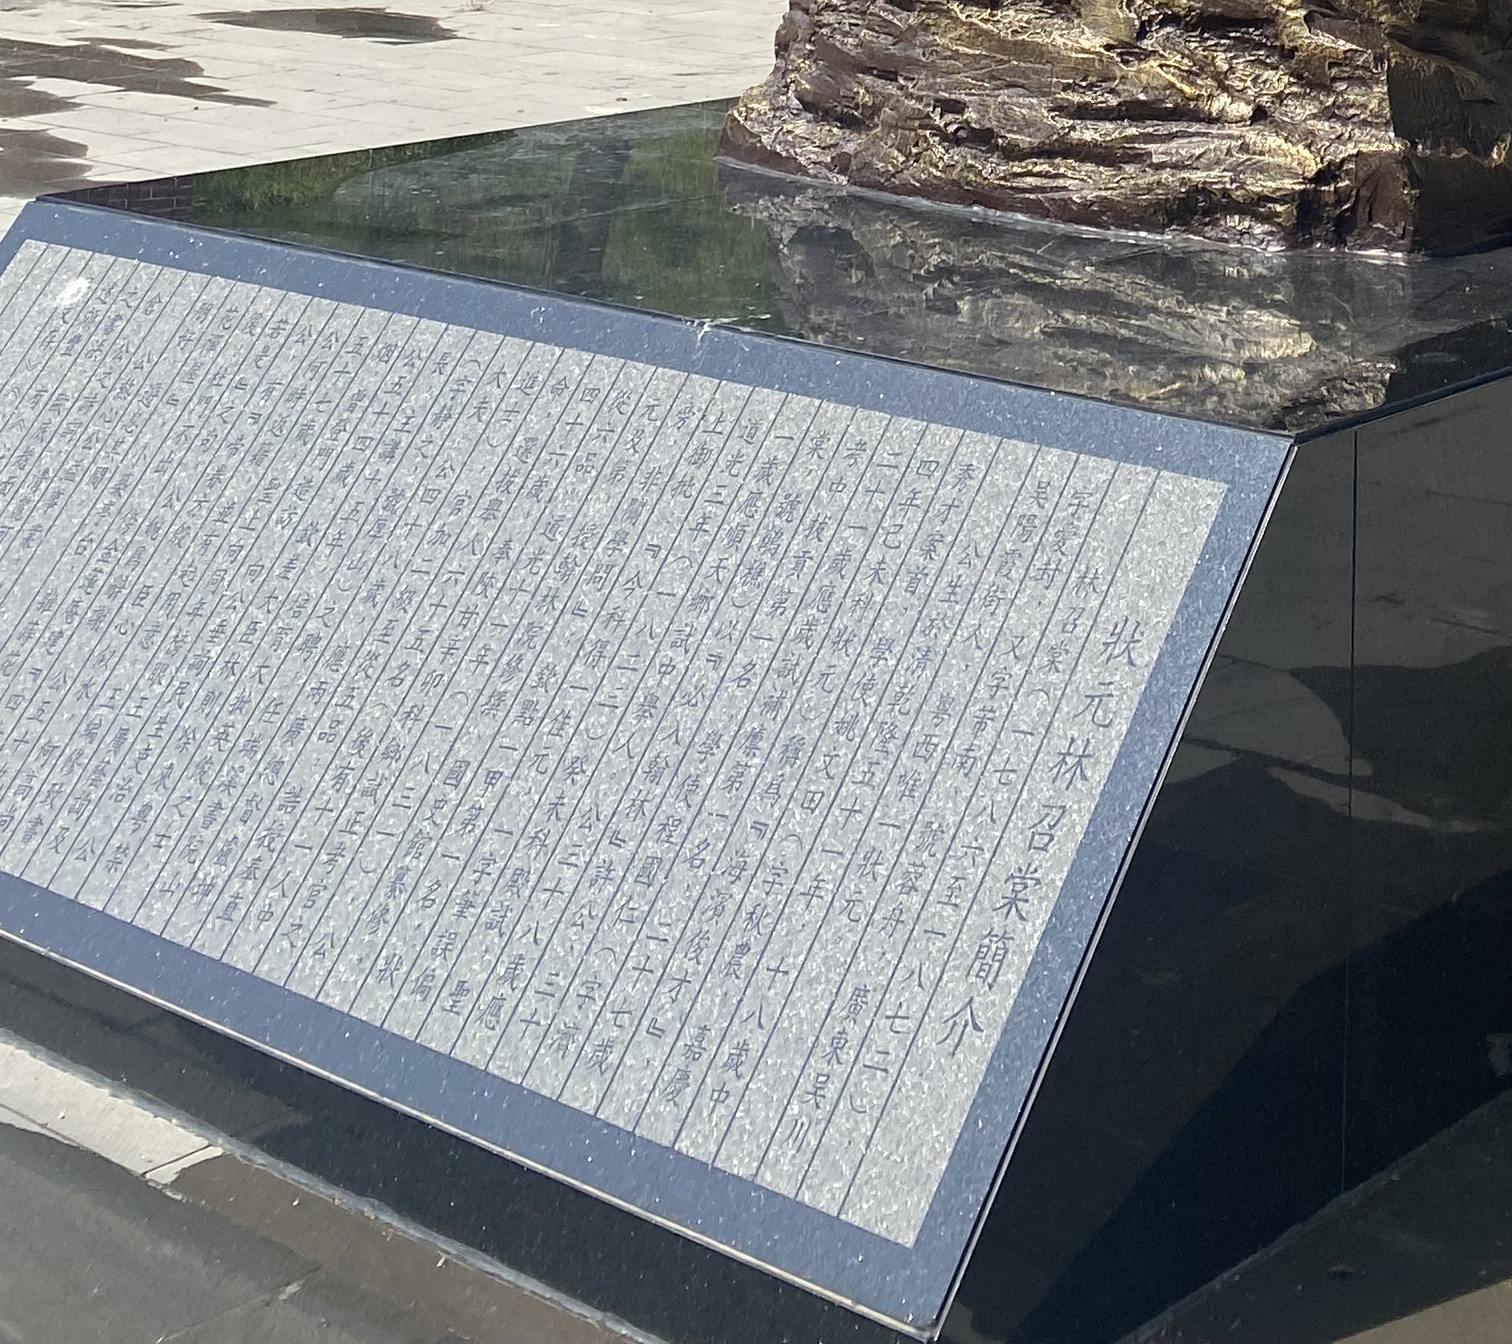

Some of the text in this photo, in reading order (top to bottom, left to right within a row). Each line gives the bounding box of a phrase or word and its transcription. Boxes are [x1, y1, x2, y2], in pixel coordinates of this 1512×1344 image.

[932, 617, 1149, 1061] 狀元林召棠簡介
